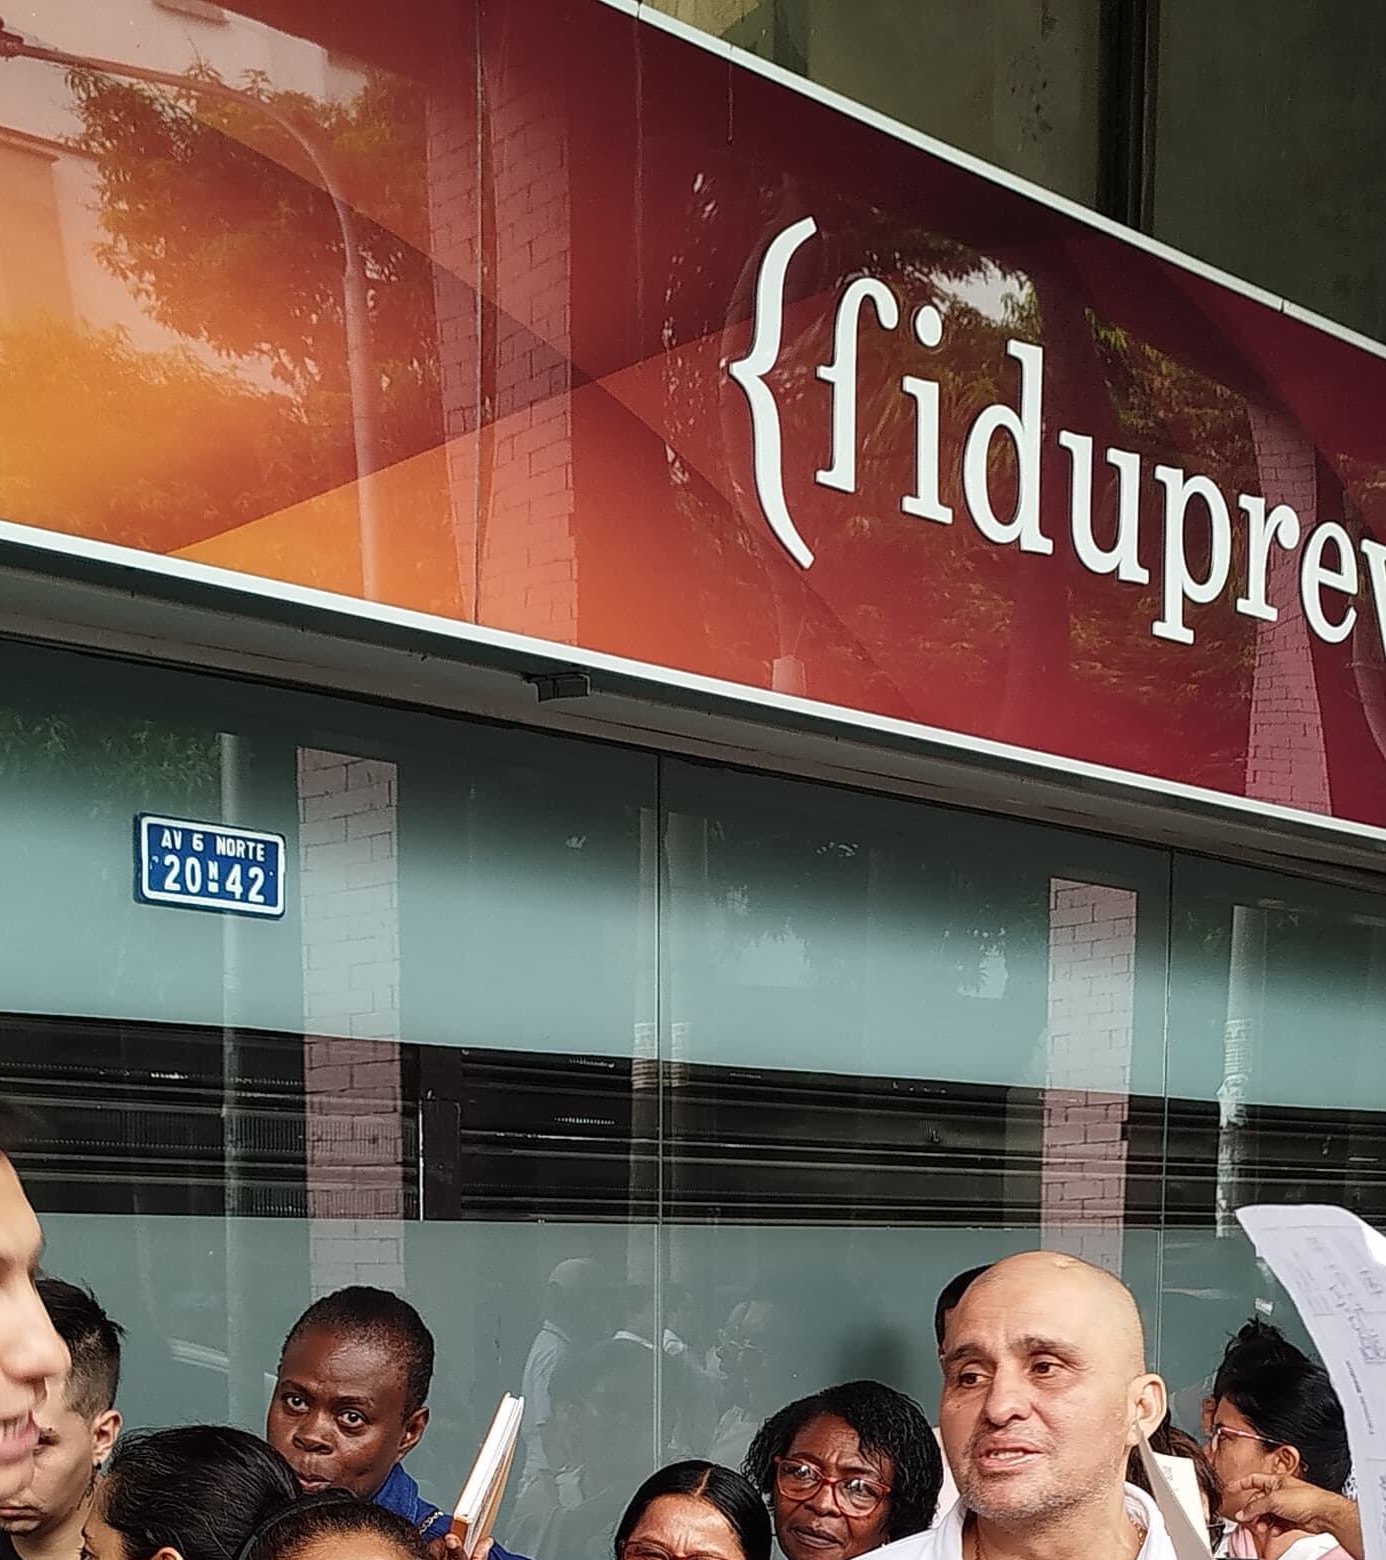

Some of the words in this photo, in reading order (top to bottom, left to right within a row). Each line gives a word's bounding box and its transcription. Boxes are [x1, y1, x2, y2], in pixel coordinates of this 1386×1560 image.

[161, 828, 182, 850] AV
[191, 832, 204, 852] 6
[215, 835, 265, 862] NORTE
